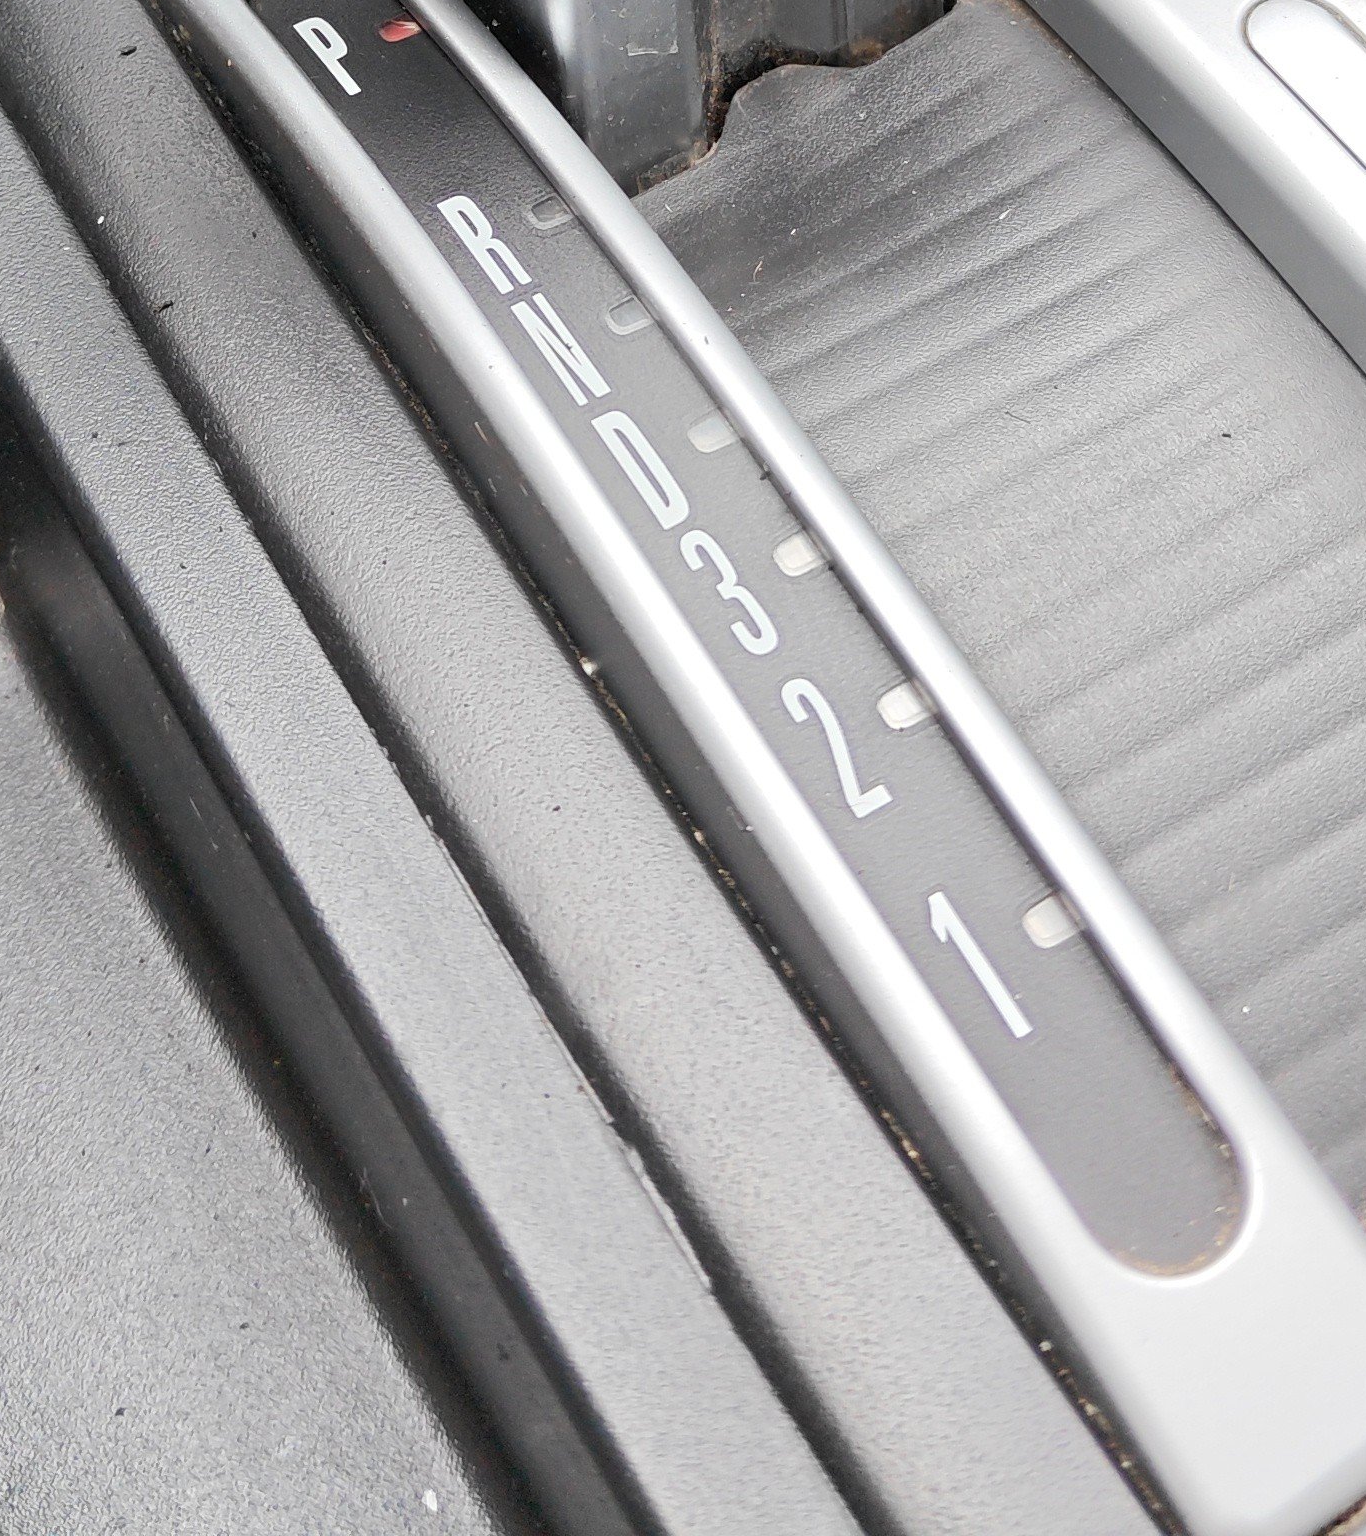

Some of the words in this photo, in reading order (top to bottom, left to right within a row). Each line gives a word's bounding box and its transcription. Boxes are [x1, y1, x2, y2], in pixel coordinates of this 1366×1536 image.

[292, 16, 362, 96] P
[436, 195, 533, 295] R
[510, 292, 612, 407] N
[590, 410, 690, 531] D
[679, 529, 779, 655] 3
[780, 678, 893, 819] 2
[927, 891, 1033, 1038] 1
